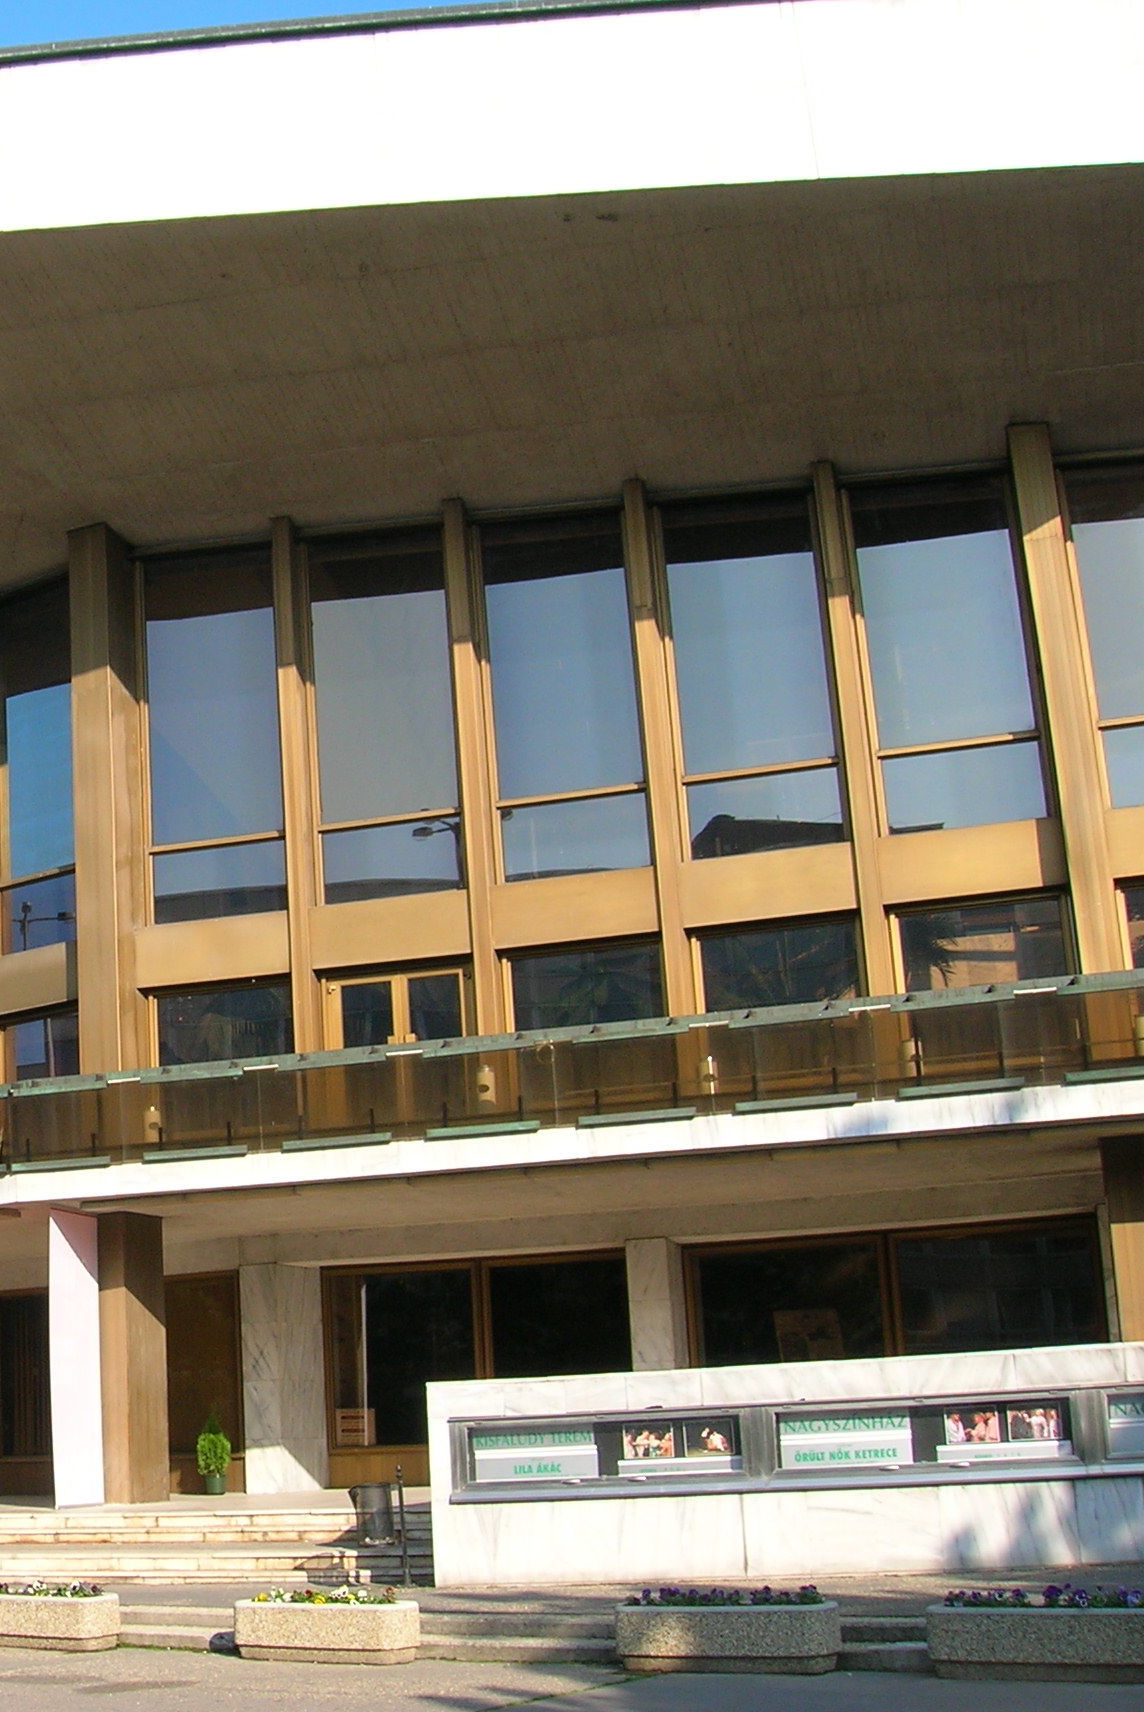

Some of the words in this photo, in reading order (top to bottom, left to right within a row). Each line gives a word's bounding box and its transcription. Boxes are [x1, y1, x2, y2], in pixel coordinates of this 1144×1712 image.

[784, 1412, 907, 1432] NAGYSZÍNHÁZ
[476, 1432, 544, 1447] KISFALUDY
[552, 1430, 593, 1444] TEREM
[855, 1448, 898, 1459] KETRECE
[514, 1464, 532, 1474] LILA
[537, 1463, 561, 1473] ÁKÁC
